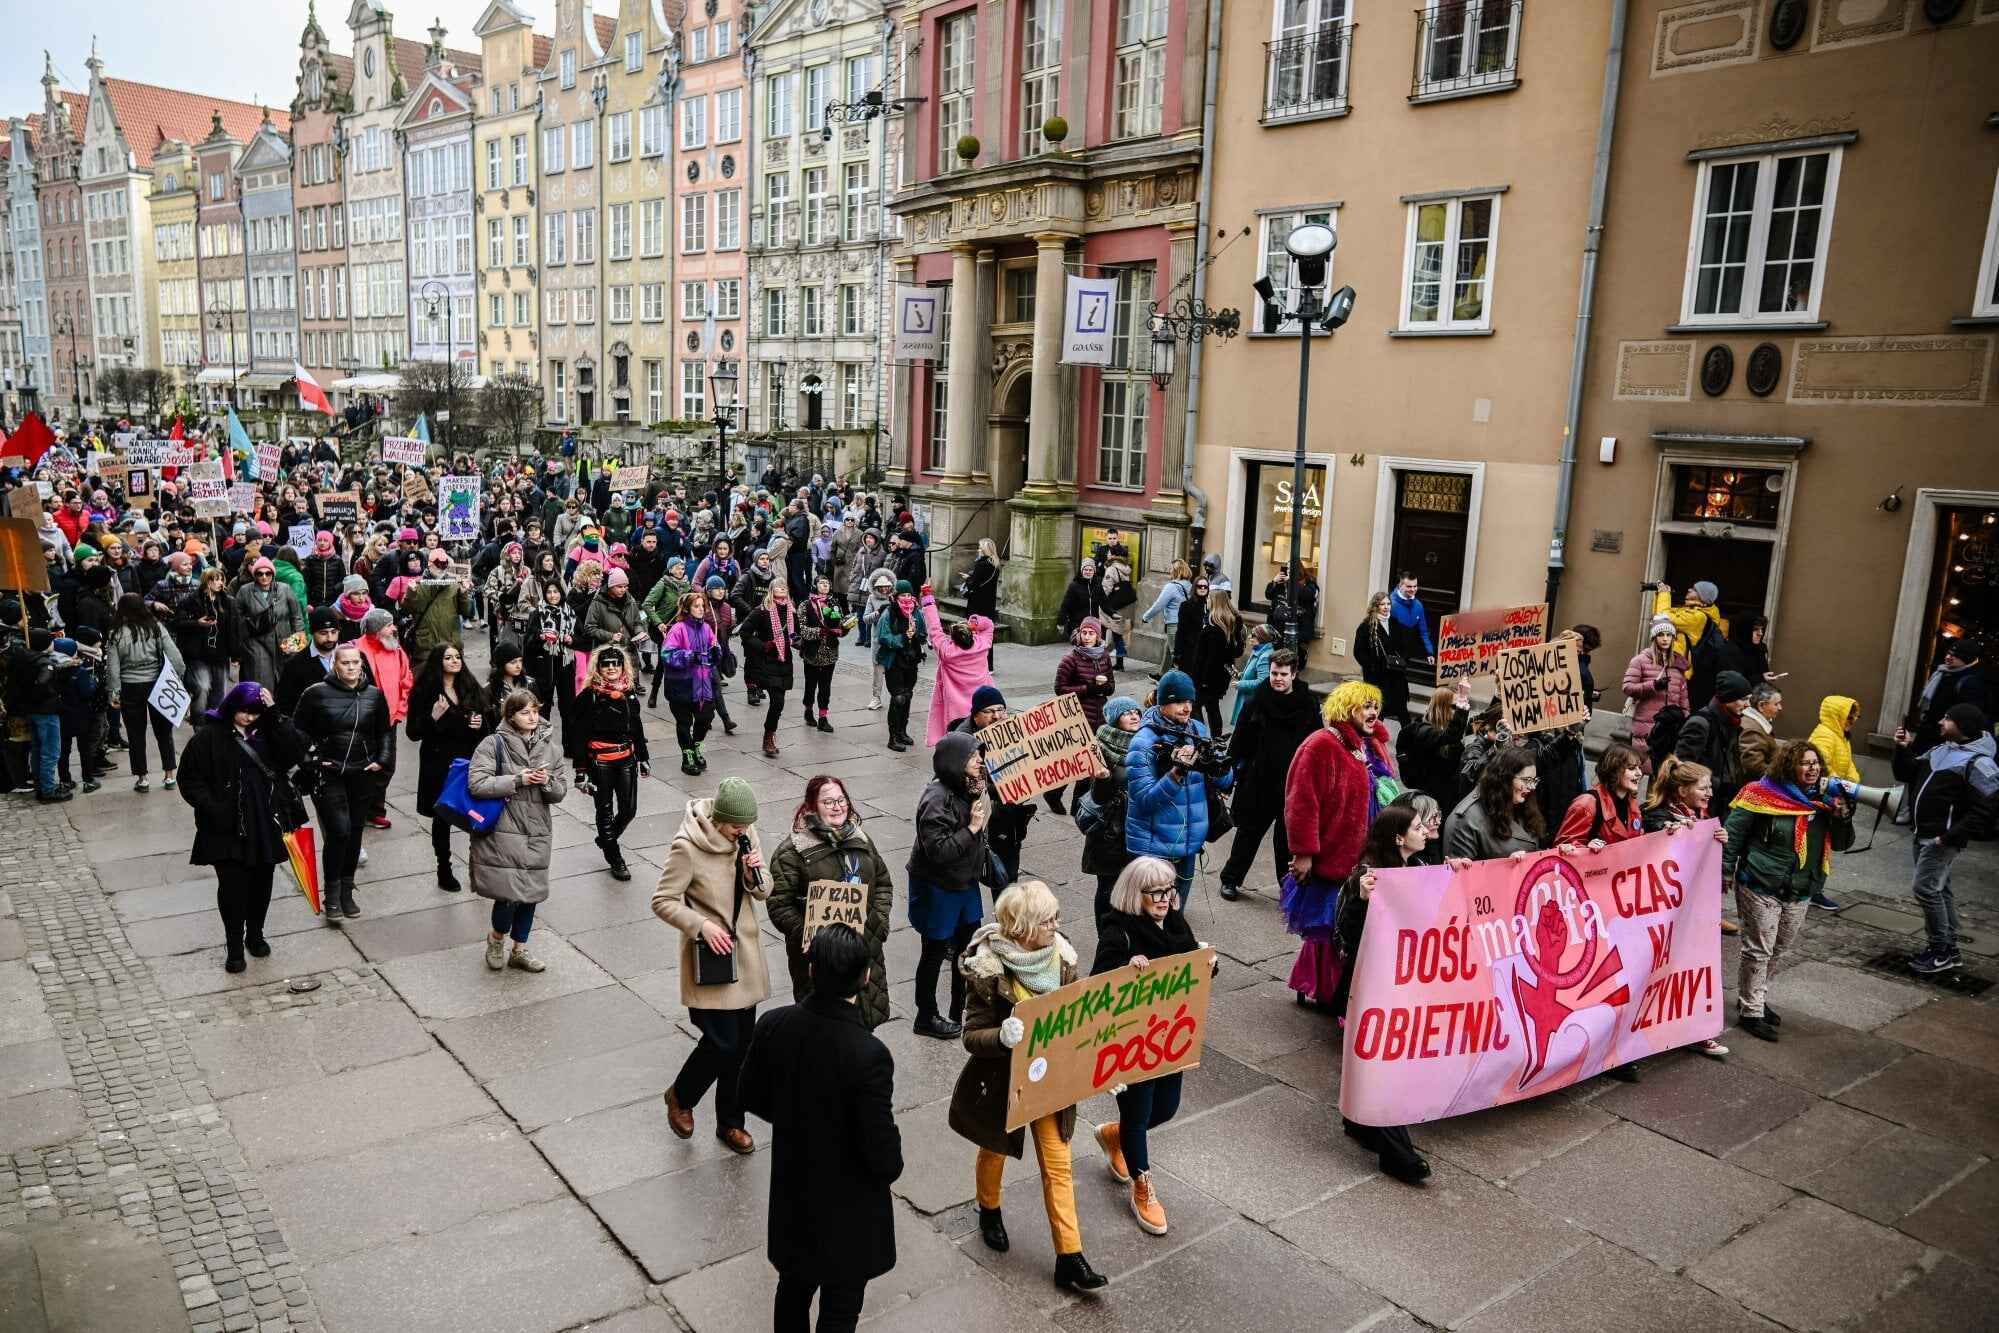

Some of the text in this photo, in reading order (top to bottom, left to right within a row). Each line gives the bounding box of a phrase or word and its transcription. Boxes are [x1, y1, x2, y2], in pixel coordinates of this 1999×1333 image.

[1072, 341, 1104, 352] GDAŃSK
[1350, 453, 1365, 466] 44
[1502, 644, 1568, 680] ZOSTAWCIE
[1504, 677, 1539, 709] MOJE
[1511, 702, 1543, 731] MAM
[1557, 691, 1580, 715] LAT
[991, 716, 1025, 750] DZIEŃ
[1022, 701, 1058, 737] KOBIET
[1027, 722, 1092, 761] LIKWIDACJI
[1033, 748, 1095, 789] PŁACOWEJ
[1474, 895, 1495, 916] 20.
[1611, 859, 1684, 919] CZAS
[821, 905, 863, 925] SAMA
[1394, 916, 1478, 986] DOŚĆ
[1647, 921, 1674, 973] NA
[1027, 961, 1199, 1059] MATKA ZIEMIA
[1630, 966, 1713, 1033] CZYNY!
[1092, 1003, 1197, 1089] DOŚĆ
[1353, 996, 1511, 1062] OBIETNIC
